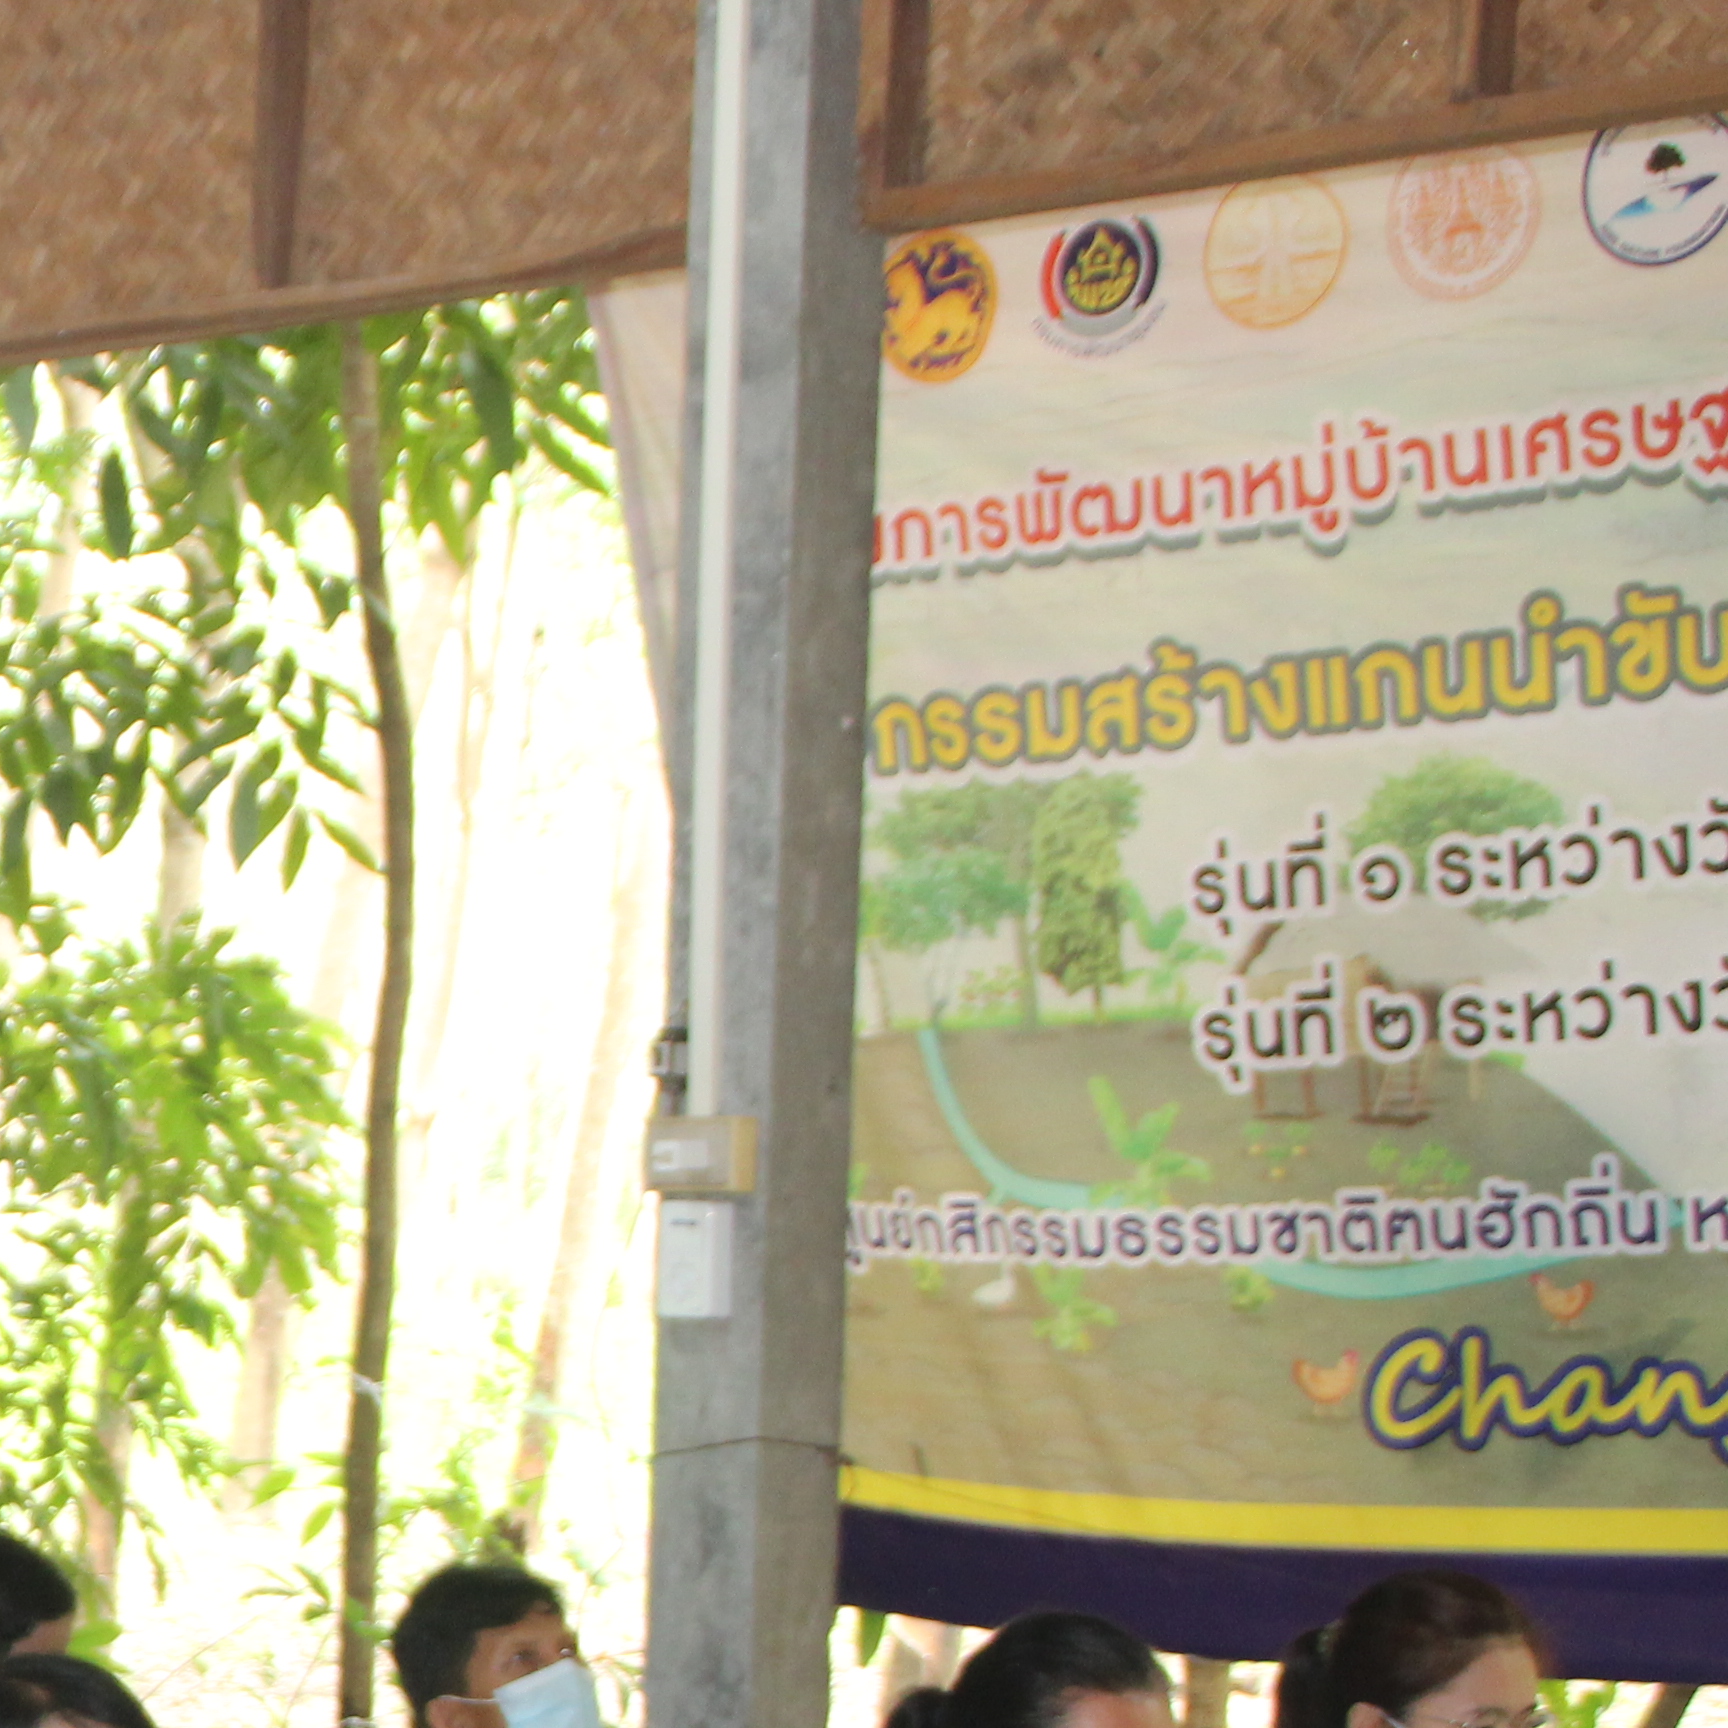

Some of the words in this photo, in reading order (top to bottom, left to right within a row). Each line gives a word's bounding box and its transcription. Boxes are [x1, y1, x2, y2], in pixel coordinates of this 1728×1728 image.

[872, 385, 1728, 564] การพัฒนาหมู่บ้านเศรษฐ
[1194, 814, 1326, 932] รุ่นที่
[1360, 853, 1404, 900] ๑
[1199, 961, 1337, 1083] รุ่นที่
[1365, 997, 1415, 1050] ๒
